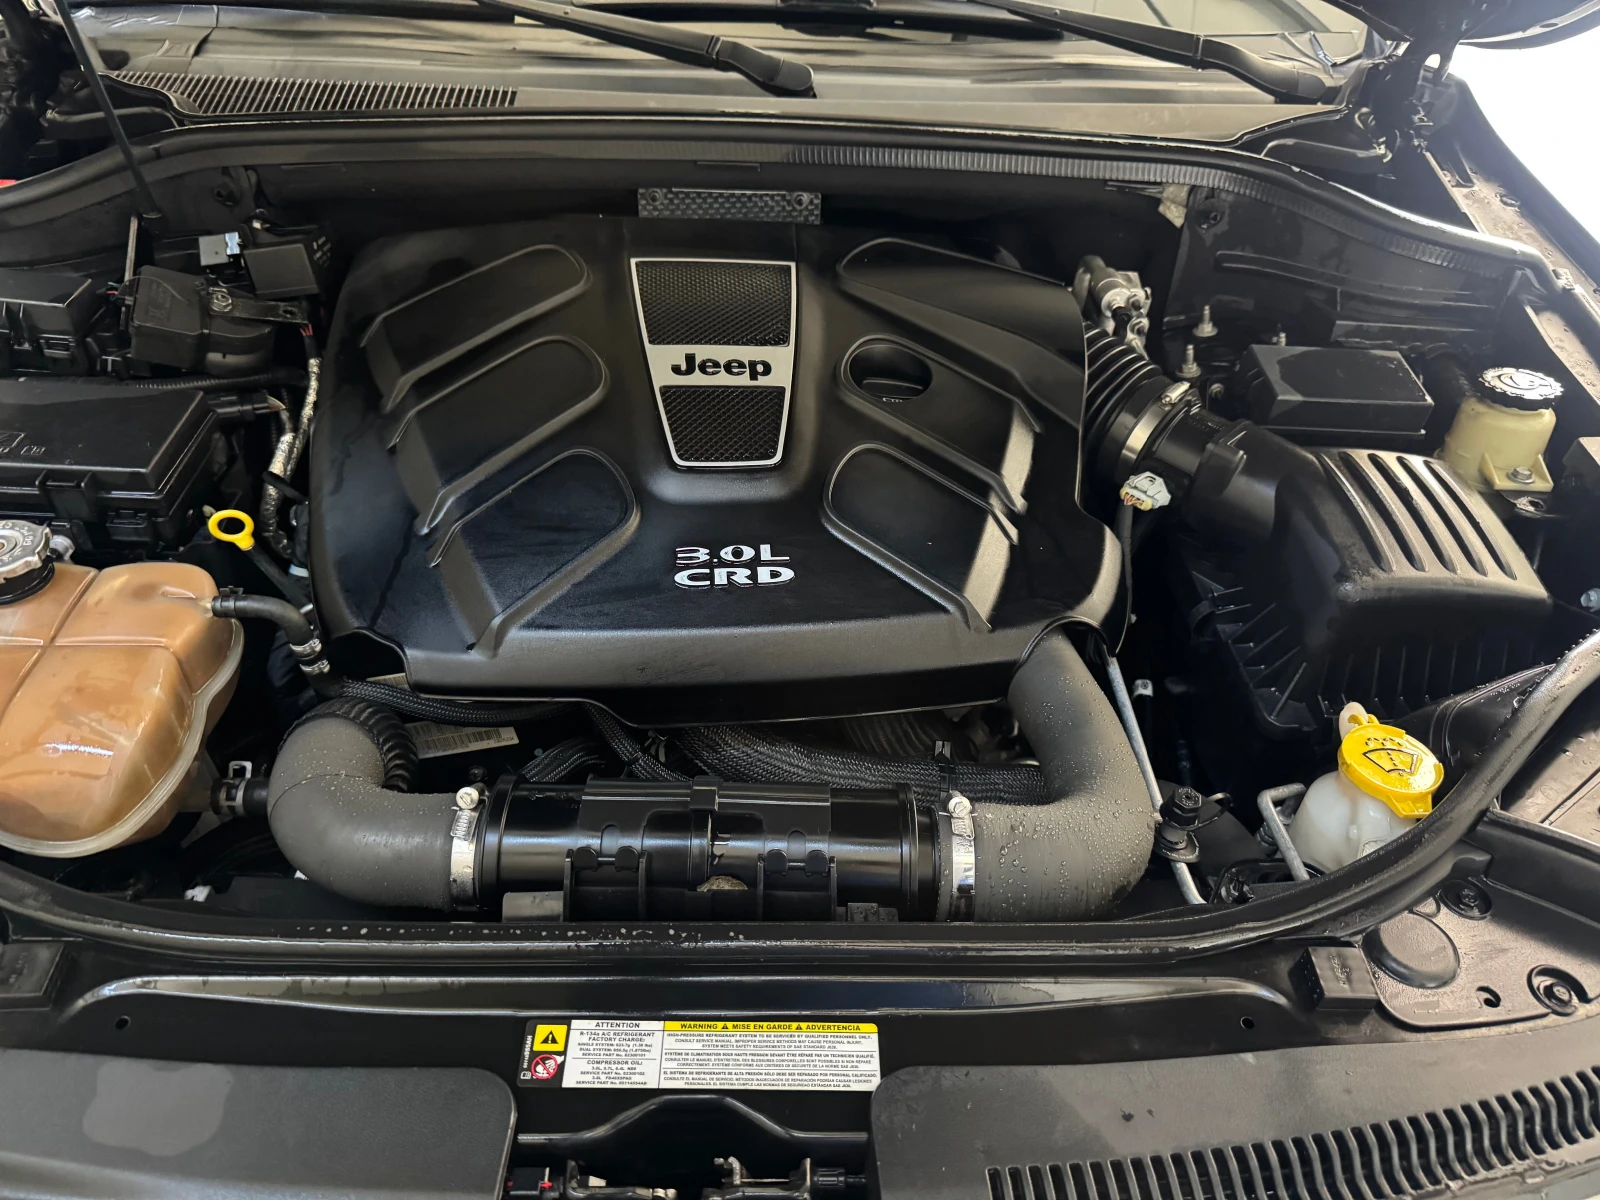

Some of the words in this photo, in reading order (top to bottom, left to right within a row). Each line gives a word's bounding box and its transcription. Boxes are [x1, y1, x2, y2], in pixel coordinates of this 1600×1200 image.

[671, 353, 772, 381] Jeep
[675, 544, 790, 566] 3.0L
[674, 566, 795, 589] CRD
